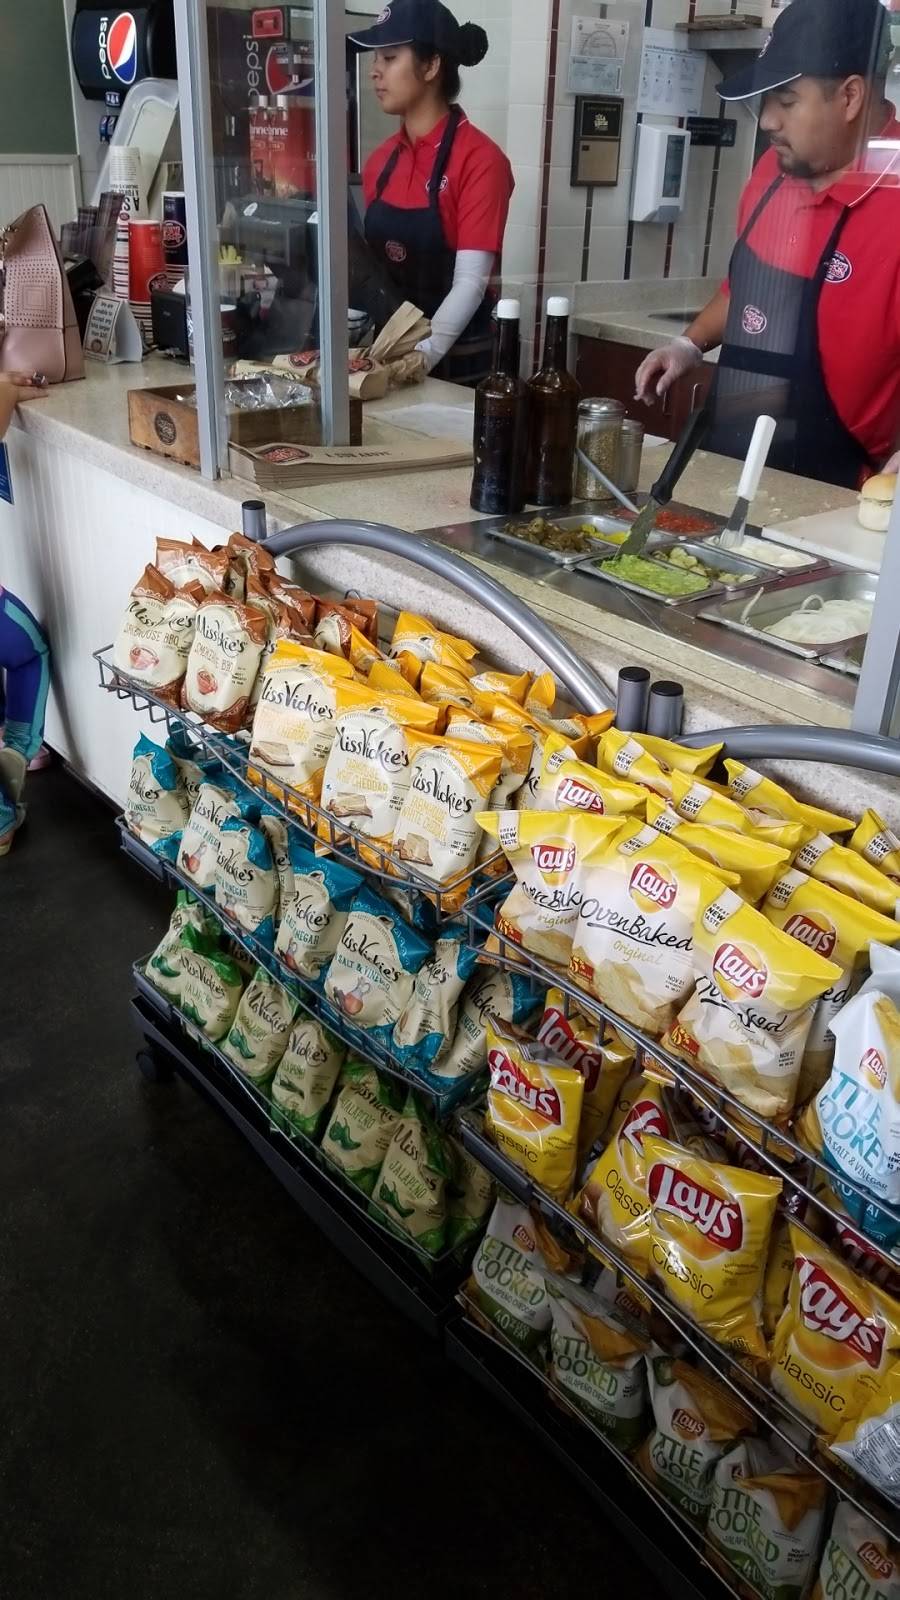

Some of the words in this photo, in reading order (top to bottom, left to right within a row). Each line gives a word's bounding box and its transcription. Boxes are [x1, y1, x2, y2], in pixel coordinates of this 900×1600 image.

[99, 17, 111, 79] pepsi
[550, 753, 564, 764] NEW
[616, 754, 632, 766] NEW
[732, 780, 750, 792] NEW
[680, 804, 698, 815] TASTE
[682, 798, 702, 810] NEW
[500, 832, 517, 841] NEW
[654, 820, 672, 832] NEW
[628, 838, 642, 850] NEW
[801, 847, 818, 860] NEW
[867, 844, 884, 858] TASTE
[872, 838, 890, 853] NEW
[533, 846, 576, 873] Lay's
[800, 854, 814, 866] TASTE
[632, 864, 675, 904] Lay's
[774, 884, 792, 897] NEW
[771, 892, 788, 903] TASTE
[704, 913, 720, 928] TASTE
[707, 907, 726, 921] NEW
[341, 922, 357, 952] iss
[786, 916, 836, 952] Lay's
[714, 944, 766, 993] Lay's
[862, 1050, 888, 1088] Lay's
[491, 1053, 556, 1116] Lay's
[832, 1142, 850, 1162] SALT
[854, 1161, 889, 1192] VINEGAR
[653, 1167, 740, 1240] Lay's
[515, 1225, 535, 1251] Lay's
[652, 1243, 714, 1300] Classic
[799, 1261, 880, 1354] Lay's
[557, 1355, 618, 1397] OOKED
[672, 1409, 705, 1434] Lay's
[715, 1508, 779, 1562] OOKED
[858, 1543, 894, 1574] Lay's
